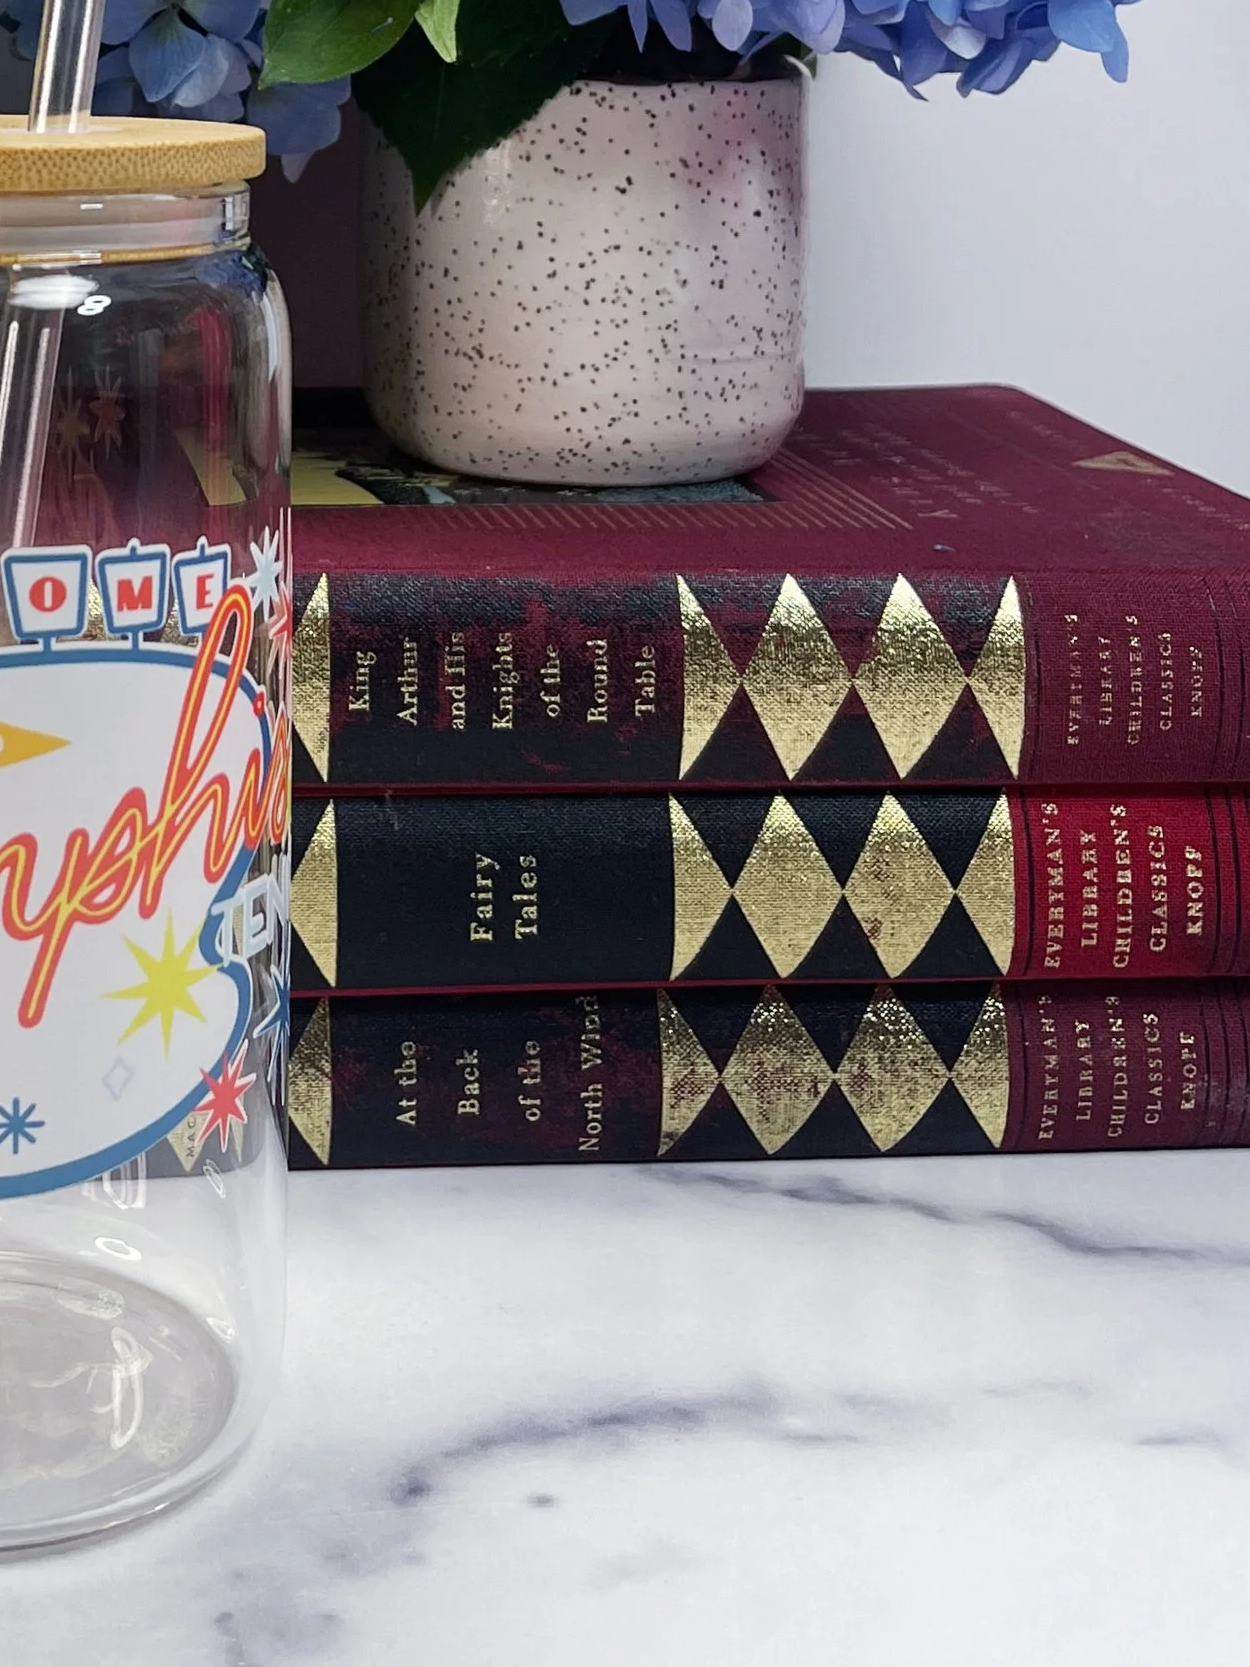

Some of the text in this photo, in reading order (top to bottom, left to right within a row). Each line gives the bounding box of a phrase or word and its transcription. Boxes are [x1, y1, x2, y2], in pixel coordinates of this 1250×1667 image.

[349, 650, 377, 713] King
[396, 636, 419, 726] Arthur
[444, 632, 467, 731] and His
[492, 632, 520, 730] Knights
[540, 643, 563, 718] of the
[586, 638, 609, 723] Round
[634, 645, 656, 717] Table
[470, 853, 501, 943] Fairy
[512, 853, 538, 940] Tales
[1040, 802, 1064, 969] EVERYMAN'S
[1079, 829, 1099, 948] LIBRARY
[1109, 804, 1133, 969] CHILDREN'S
[1147, 825, 1168, 952] CLASSICS
[1183, 845, 1205, 937] KNOPF
[394, 1040, 418, 1127] At the
[456, 1048, 480, 1116] Back
[518, 1094, 542, 1122] of
[1038, 994, 1060, 1141] EVERYMAN'S
[1075, 1019, 1094, 1122] LIBRARY
[1105, 995, 1129, 1138] CHILDREN'S
[1142, 1013, 1163, 1125] CLASSICS
[578, 1082, 603, 1152] North
